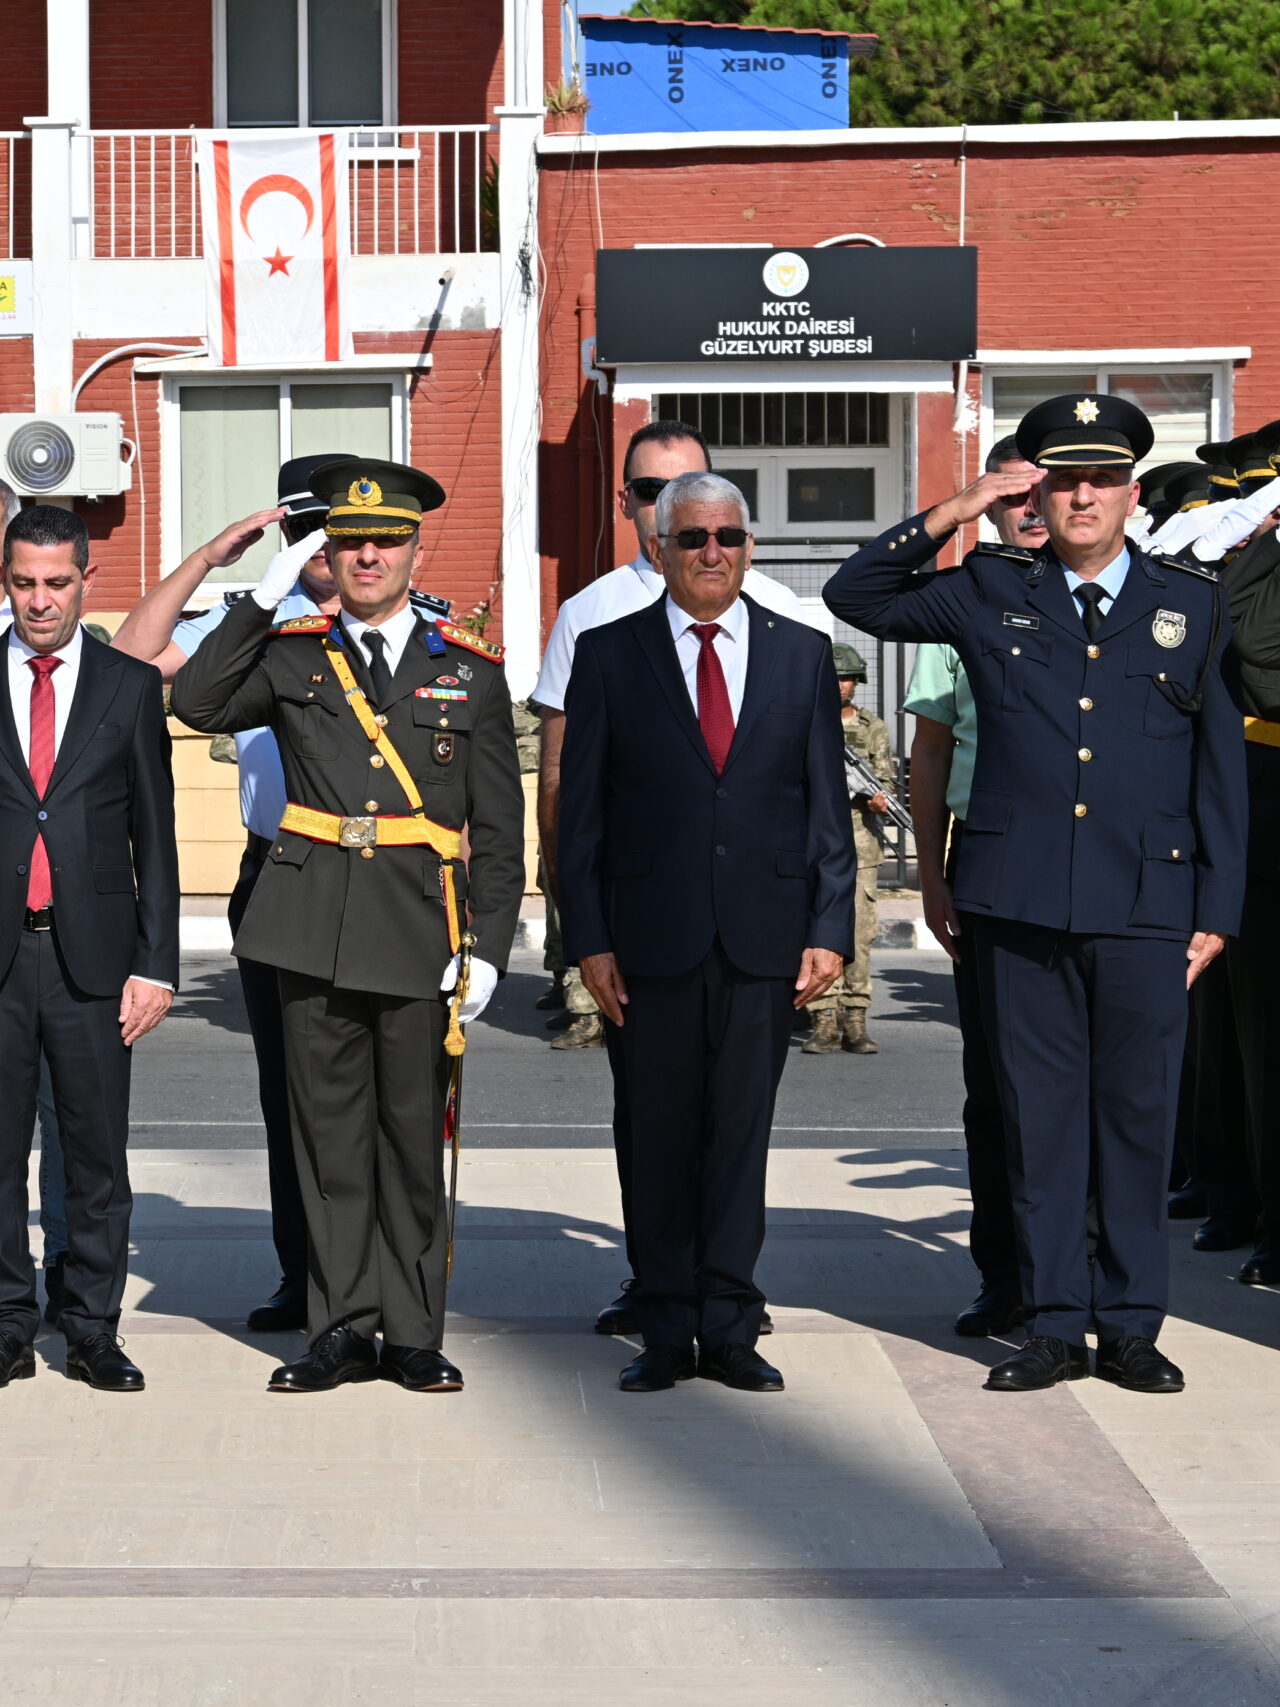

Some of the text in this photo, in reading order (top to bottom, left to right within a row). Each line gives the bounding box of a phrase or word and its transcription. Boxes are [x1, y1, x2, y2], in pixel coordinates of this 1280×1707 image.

[586, 61, 632, 76] ONE
[668, 32, 684, 103] ONEX
[722, 57, 786, 73] ONEX
[762, 301, 811, 317] KKTC
[717, 316, 855, 337] HUKUK DAİRESİ
[700, 336, 873, 357] GÜZELYURT ŞUBESİ
